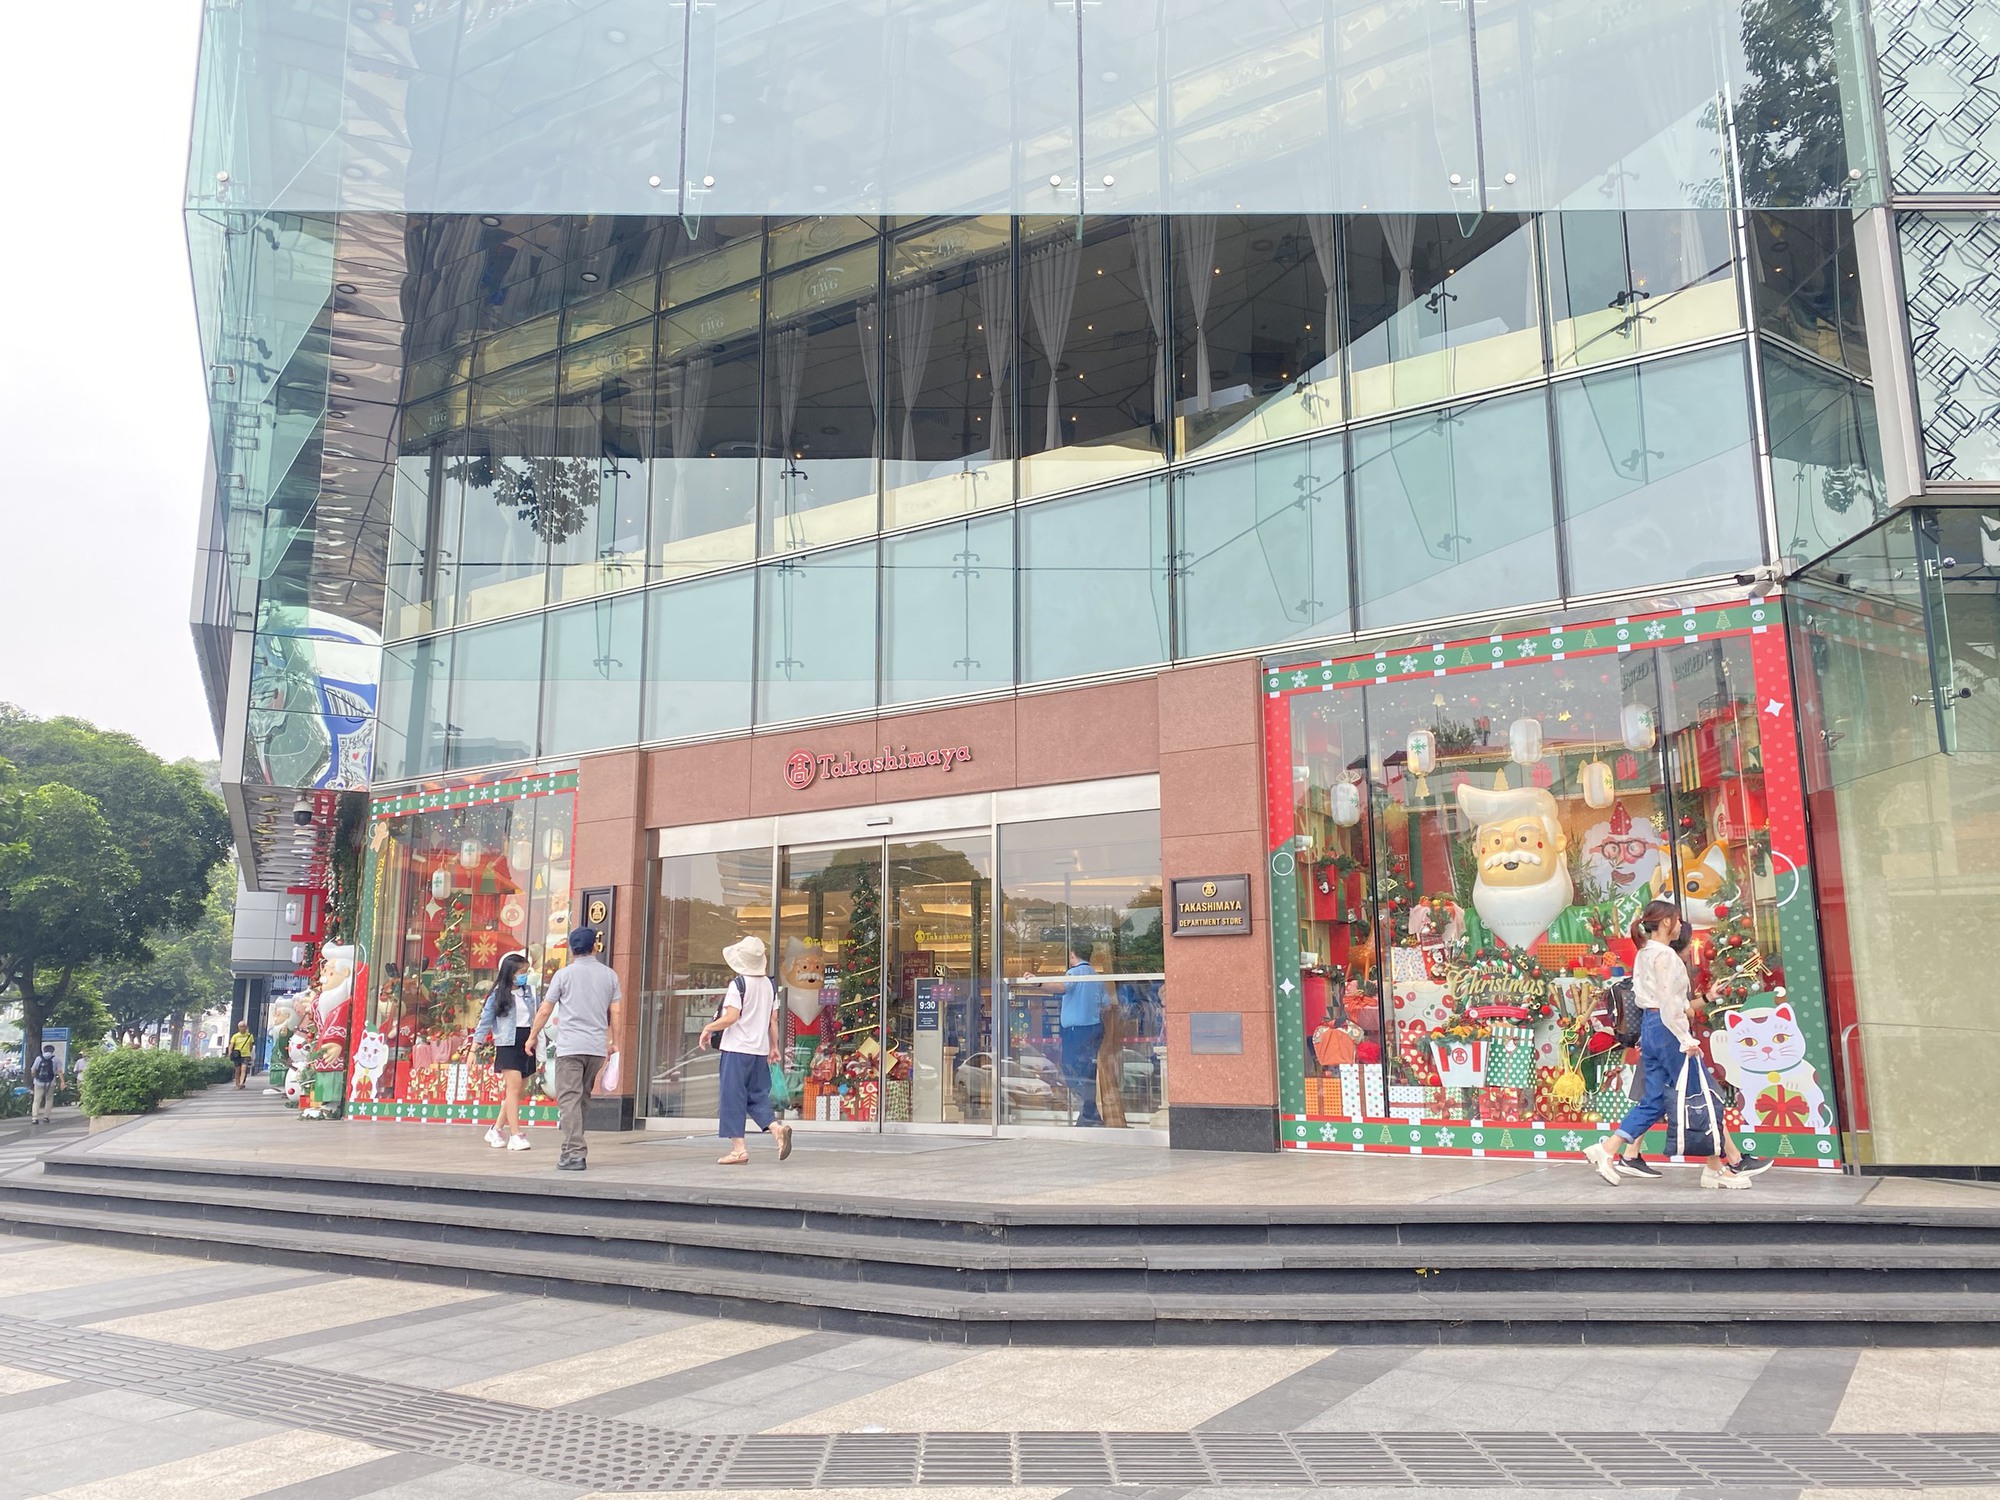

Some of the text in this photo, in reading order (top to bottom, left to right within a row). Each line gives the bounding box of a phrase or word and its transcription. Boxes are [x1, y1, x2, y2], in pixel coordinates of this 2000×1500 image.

[817, 744, 971, 779] Takashimaya
[1179, 900, 1242, 913] TAKASHIMAYA
[1179, 917, 1243, 927] DEPARTMENT STORE
[924, 931, 972, 942] Takashimaya
[1480, 965, 1508, 976] MERRY
[1446, 968, 1546, 1000] Christmas
[919, 1000, 936, 1010] 9:30
